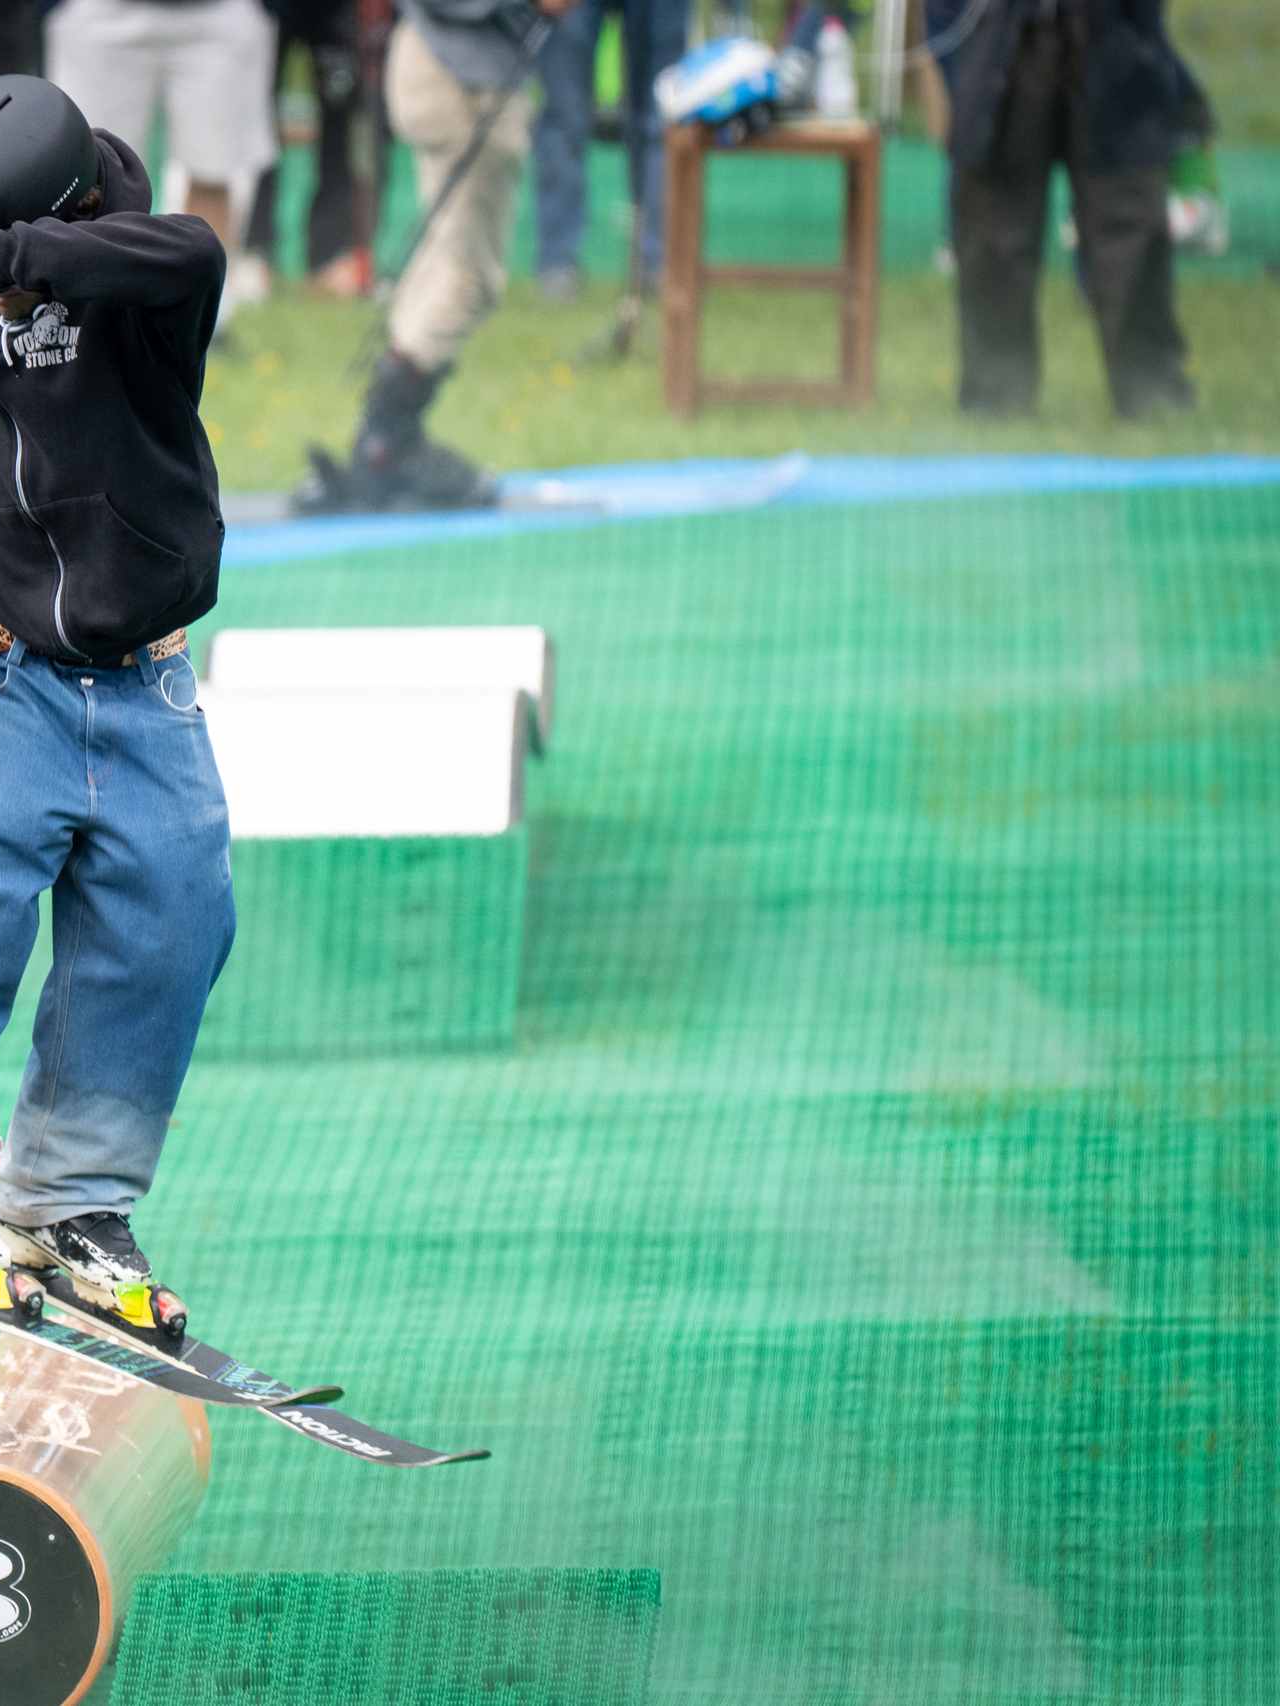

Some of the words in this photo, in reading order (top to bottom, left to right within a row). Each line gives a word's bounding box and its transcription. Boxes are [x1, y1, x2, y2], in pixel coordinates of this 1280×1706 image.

[25, 350, 62, 369] STONE
[64, 346, 78, 362] CO.
[279, 1410, 393, 1457] FACTION
